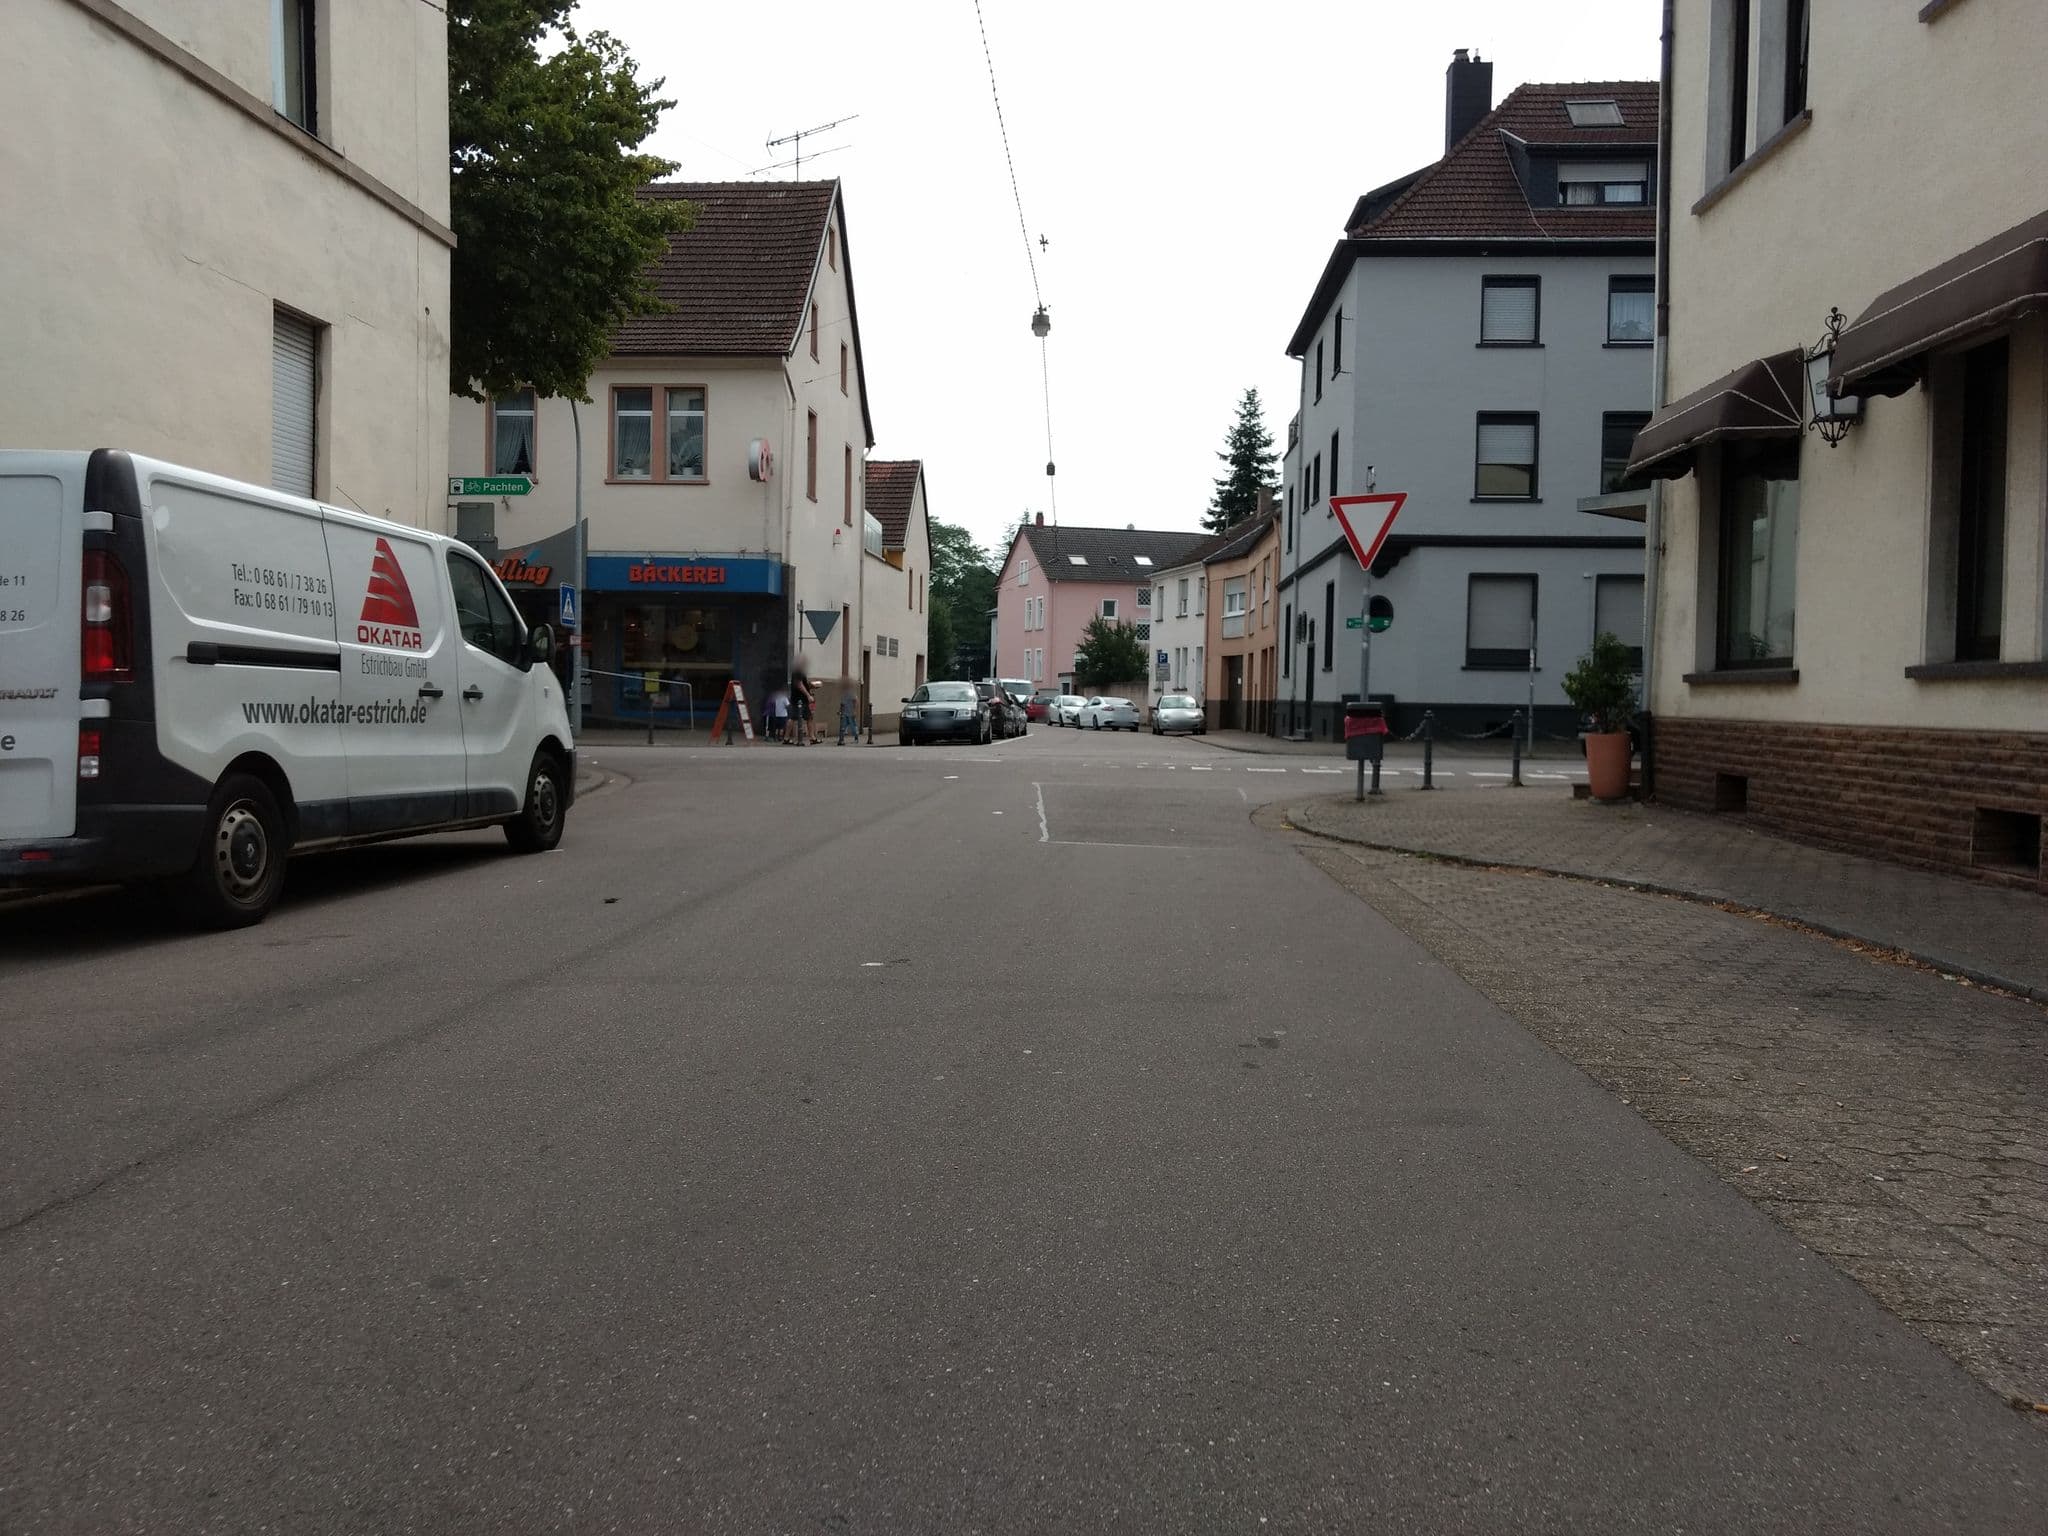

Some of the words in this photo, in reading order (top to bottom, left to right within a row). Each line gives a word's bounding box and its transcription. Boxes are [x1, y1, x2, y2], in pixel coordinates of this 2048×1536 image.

[483, 482, 523, 492] Pachten
[14, 575, 25, 586] 11
[232, 563, 252, 583] Tel.:
[254, 567, 260, 584] 0
[263, 569, 274, 586] 68
[277, 571, 287, 589] 61
[296, 574, 301, 591] 7
[303, 576, 315, 592] 38
[316, 578, 327, 595] 26
[234, 588, 253, 607] Fax:
[255, 591, 262, 608] 0
[264, 593, 276, 610] 68
[279, 595, 289, 612] 61
[297, 597, 308, 615] 79
[311, 600, 321, 616] 10
[323, 601, 333, 618] 13
[11, 610, 25, 622] 26
[357, 625, 422, 648] OKATAR
[361, 653, 403, 677] Estrichbau
[405, 657, 428, 679] GmbH
[242, 696, 427, 724] www.okatar-estrich.de
